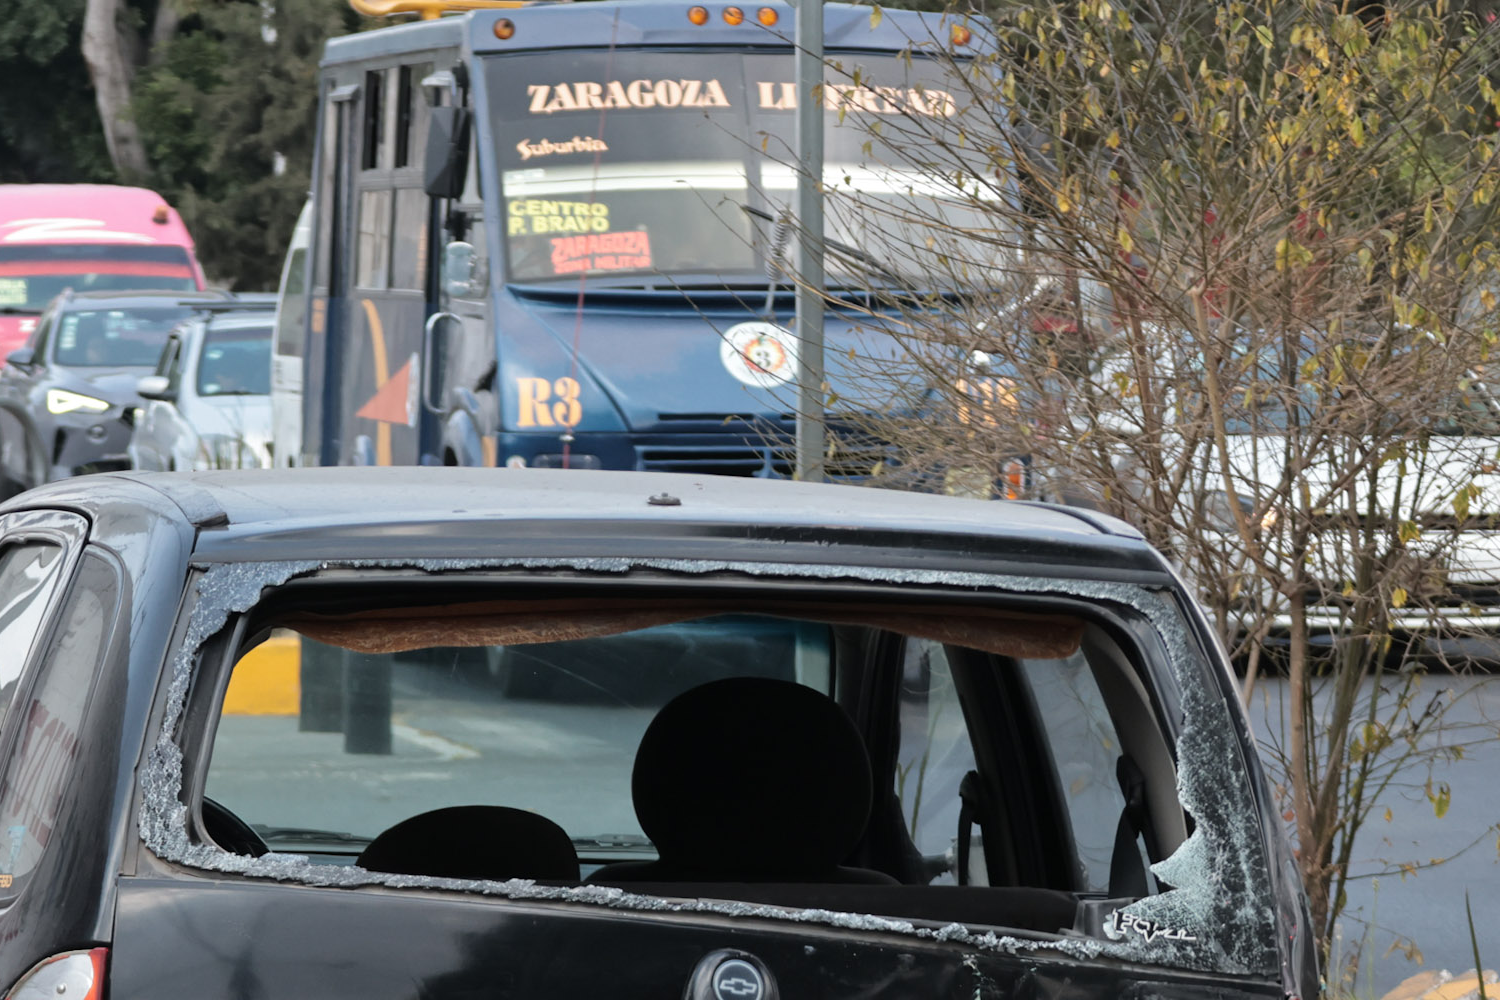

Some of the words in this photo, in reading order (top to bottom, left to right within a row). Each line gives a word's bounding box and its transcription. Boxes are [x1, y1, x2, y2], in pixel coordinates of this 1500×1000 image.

[527, 79, 731, 114] ZARAGOZA
[757, 82, 958, 118] LIERTAD
[516, 136, 608, 160] Suburbia
[508, 200, 609, 217] CENTRO
[508, 217, 527, 236] P.
[532, 215, 610, 234] BRAVO
[516, 377, 582, 427] R3
